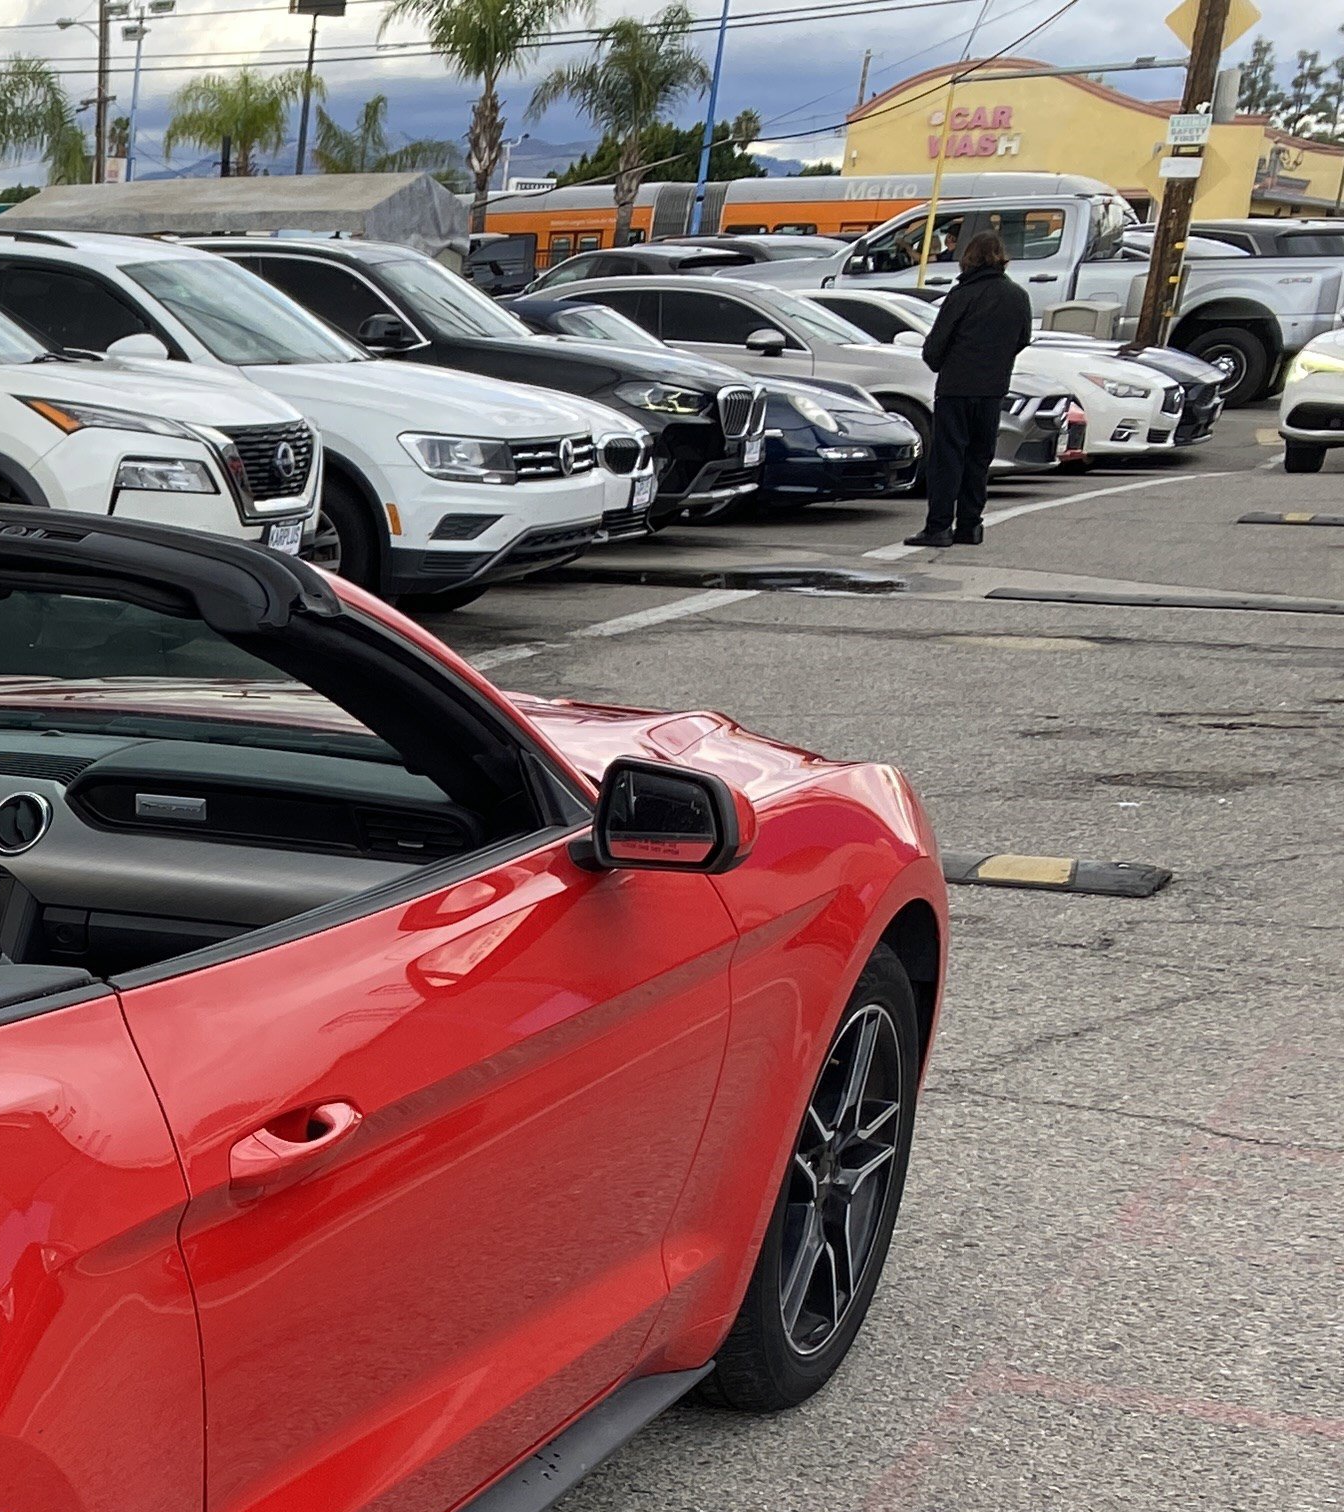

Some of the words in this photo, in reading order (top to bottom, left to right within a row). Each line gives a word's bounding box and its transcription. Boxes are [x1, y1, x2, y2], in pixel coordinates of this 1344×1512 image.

[950, 106, 1013, 131] CAR
[928, 133, 1022, 158] WASH
[845, 180, 917, 200] Metro
